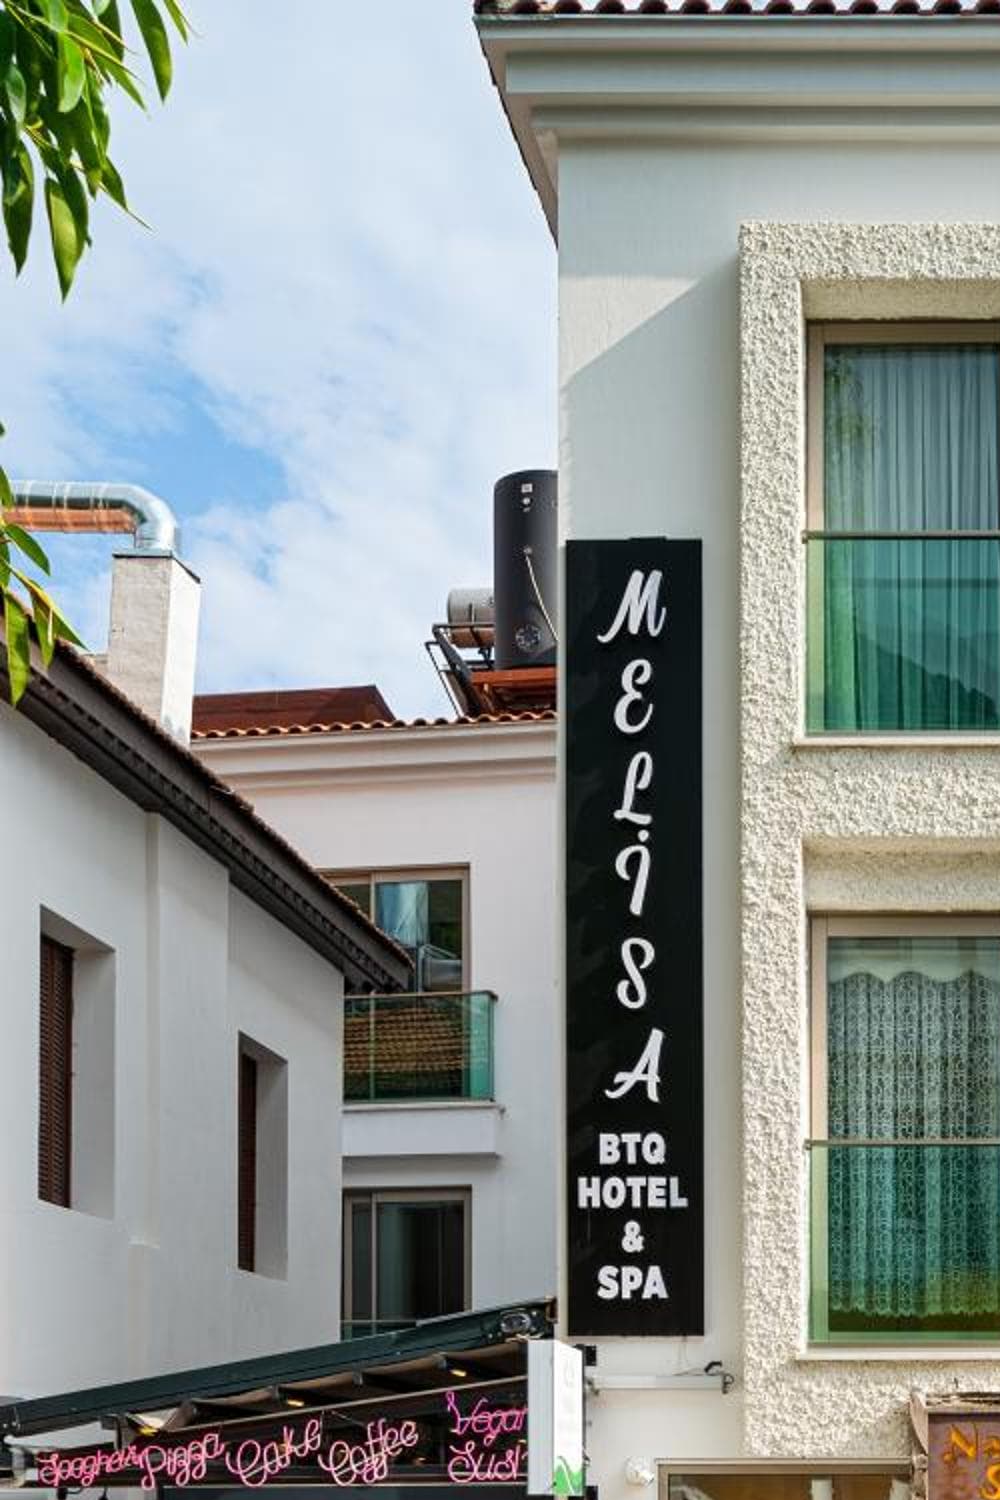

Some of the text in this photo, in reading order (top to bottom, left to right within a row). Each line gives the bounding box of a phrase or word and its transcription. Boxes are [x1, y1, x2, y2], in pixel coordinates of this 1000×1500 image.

[599, 1132, 666, 1165] BTQ
[577, 1176, 689, 1209] HOTEL
[621, 1220, 645, 1252] &
[597, 1265, 669, 1299] SPA
[140, 1432, 226, 1490] Pizza
[226, 1418, 321, 1487] Cake
[317, 1417, 419, 1487] Coffee
